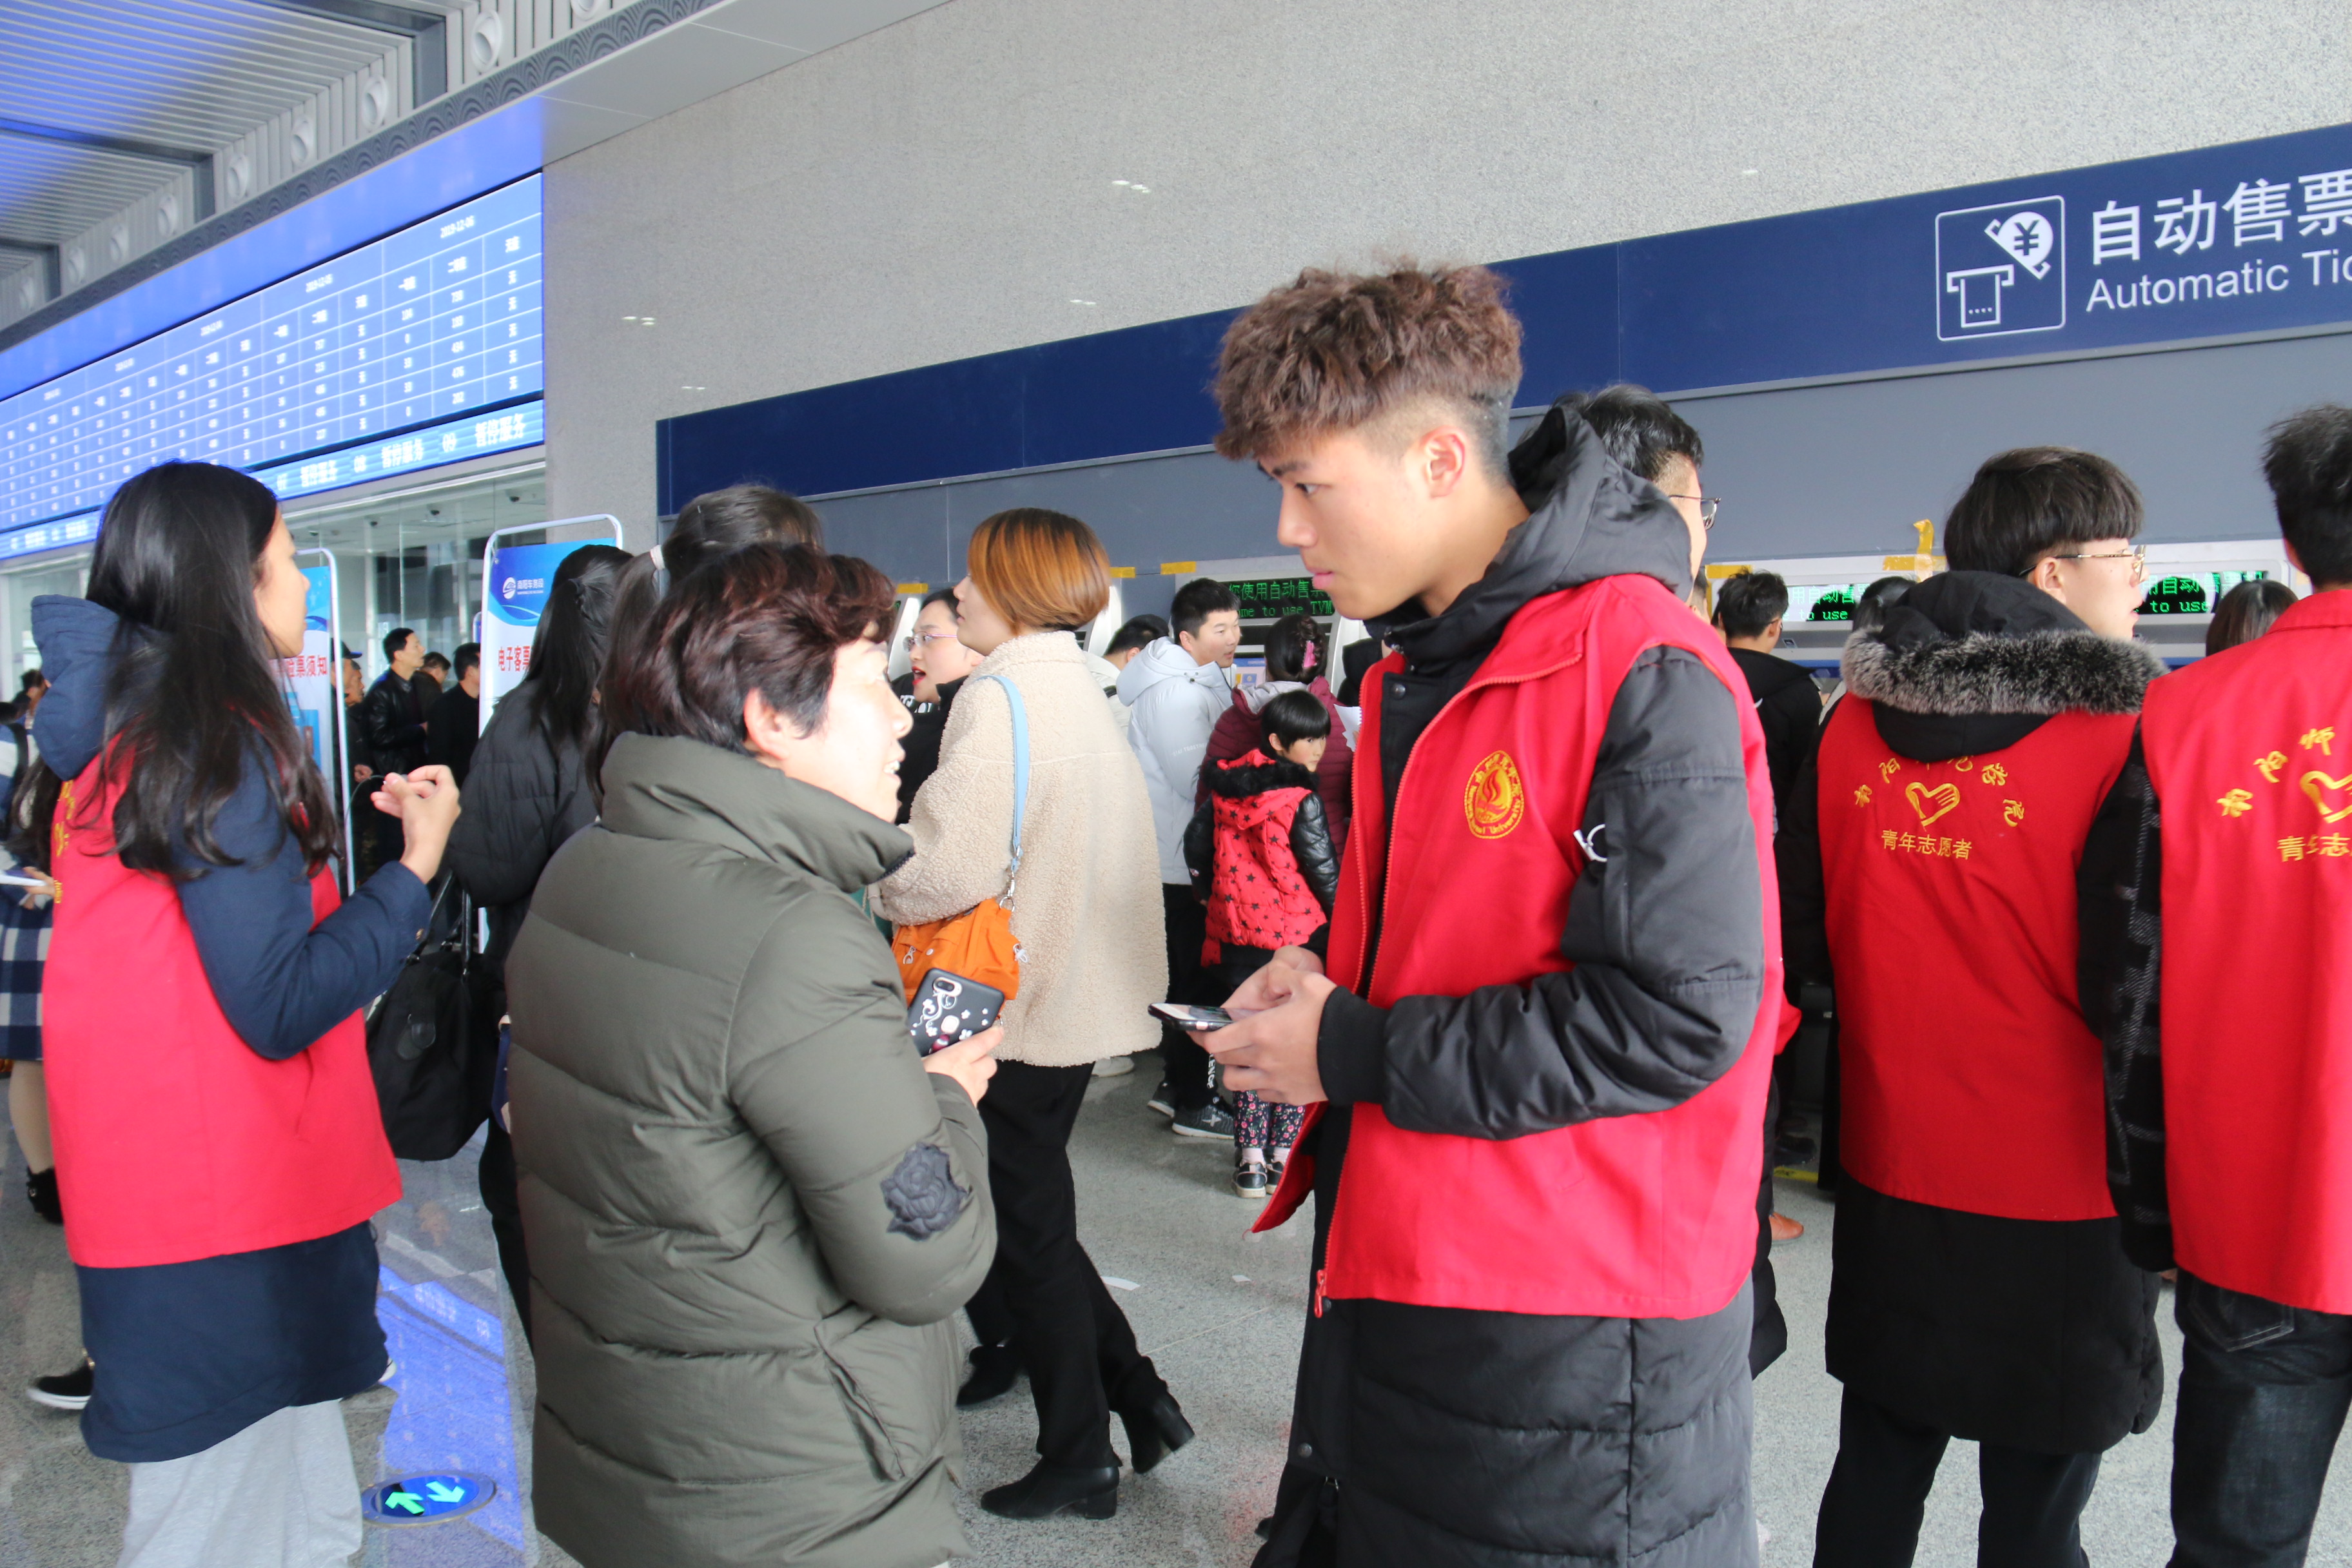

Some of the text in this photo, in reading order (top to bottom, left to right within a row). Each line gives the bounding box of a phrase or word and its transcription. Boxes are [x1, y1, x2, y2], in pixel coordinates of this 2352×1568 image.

[2092, 169, 2352, 266] 自动售票
[2086, 259, 2289, 312] Automatic
[474, 413, 527, 447] 暂停服务
[1822, 611, 1848, 620] use
[2150, 600, 2210, 612] to use
[1881, 828, 1973, 860] 青年志愿者
